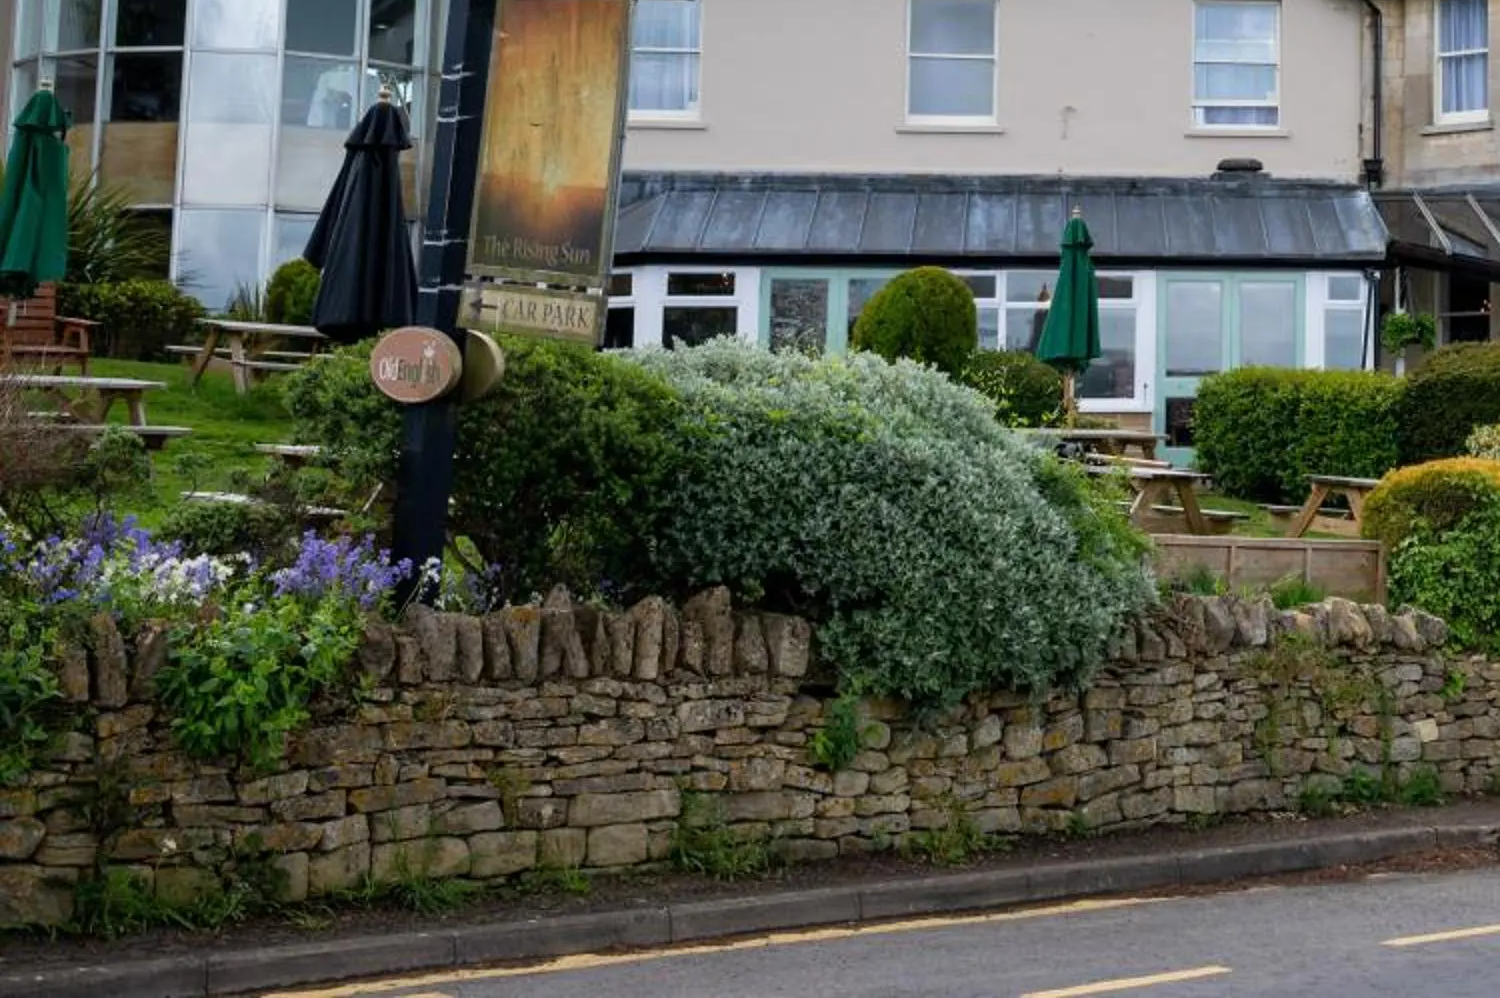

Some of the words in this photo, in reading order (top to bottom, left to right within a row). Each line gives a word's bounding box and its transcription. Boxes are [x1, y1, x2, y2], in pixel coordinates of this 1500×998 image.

[484, 234, 512, 258] The
[513, 237, 559, 267] Rising
[560, 238, 591, 265] Sun
[502, 297, 538, 323] CAR
[543, 301, 591, 329] PARK
